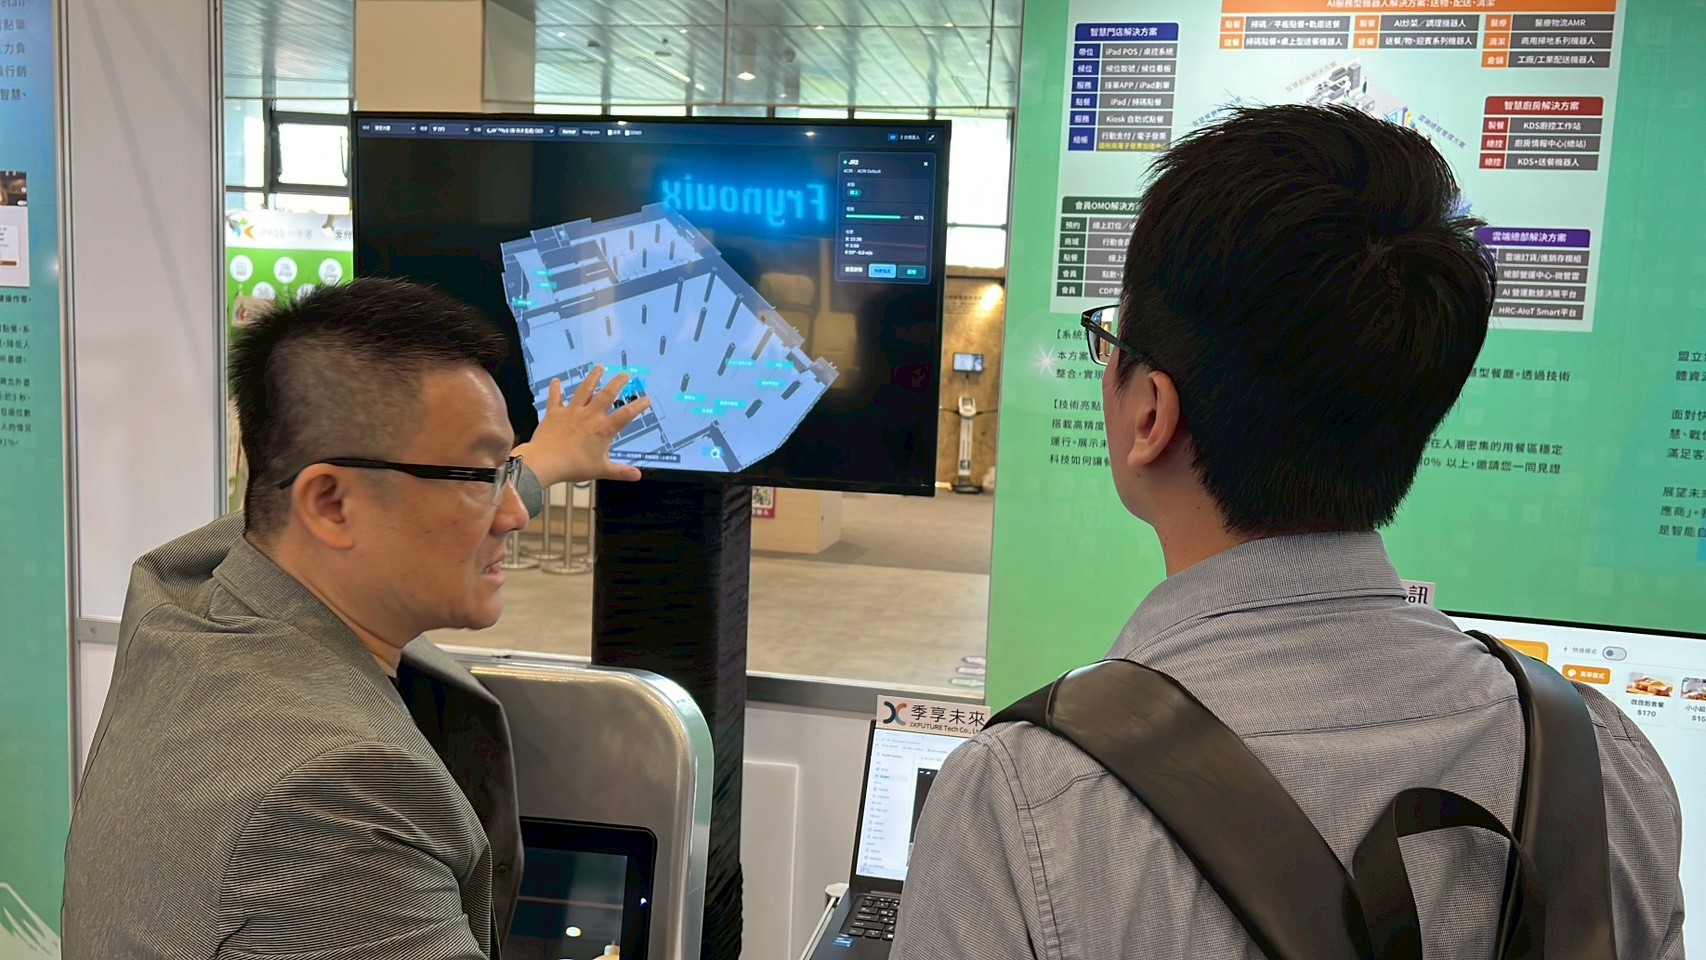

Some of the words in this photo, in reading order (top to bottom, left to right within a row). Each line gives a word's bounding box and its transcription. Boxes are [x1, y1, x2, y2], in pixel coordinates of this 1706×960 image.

[1490, 19, 1507, 28] 醫療
[1535, 18, 1586, 27] 醫療物流AMR
[1090, 27, 1158, 37] 智慧門店解決方案
[1224, 38, 1240, 47] 送餐
[1358, 37, 1375, 46] 送餐
[1521, 36, 1596, 46] 商用掃地系列機器人
[0, 42, 25, 54] 力負
[1105, 48, 1121, 56] iPad
[1123, 48, 1138, 56] POS
[1110, 98, 1127, 106] iPad
[1504, 101, 1580, 111] 智慧廚房解決方案
[1106, 115, 1126, 123] Kiosk
[1523, 122, 1581, 131] KDS廚控工作站
[1517, 157, 1580, 167] KDS+送餐機器人
[1492, 231, 1567, 243] 雲端總部解決方案
[1108, 254, 1126, 262] 線上
[1062, 270, 1077, 278] 會員
[1061, 286, 1076, 294] 會員
[1502, 288, 1510, 296] AI
[1536, 307, 1577, 318] Smart平台
[1057, 351, 1089, 361] 本方案
[1678, 350, 1706, 362] 盟立
[1053, 398, 1104, 411] 【技術亮點
[1052, 418, 1104, 431] 搭載高精度
[1431, 438, 1563, 456] 在人潮密集的用餐區穩定
[1408, 585, 1428, 604] 訊
[911, 704, 985, 727] 季享未來
[1637, 709, 1656, 717] $170
[909, 721, 942, 731] JXFUTURE
[944, 725, 959, 733] Tech
[960, 727, 971, 735] Co.,
